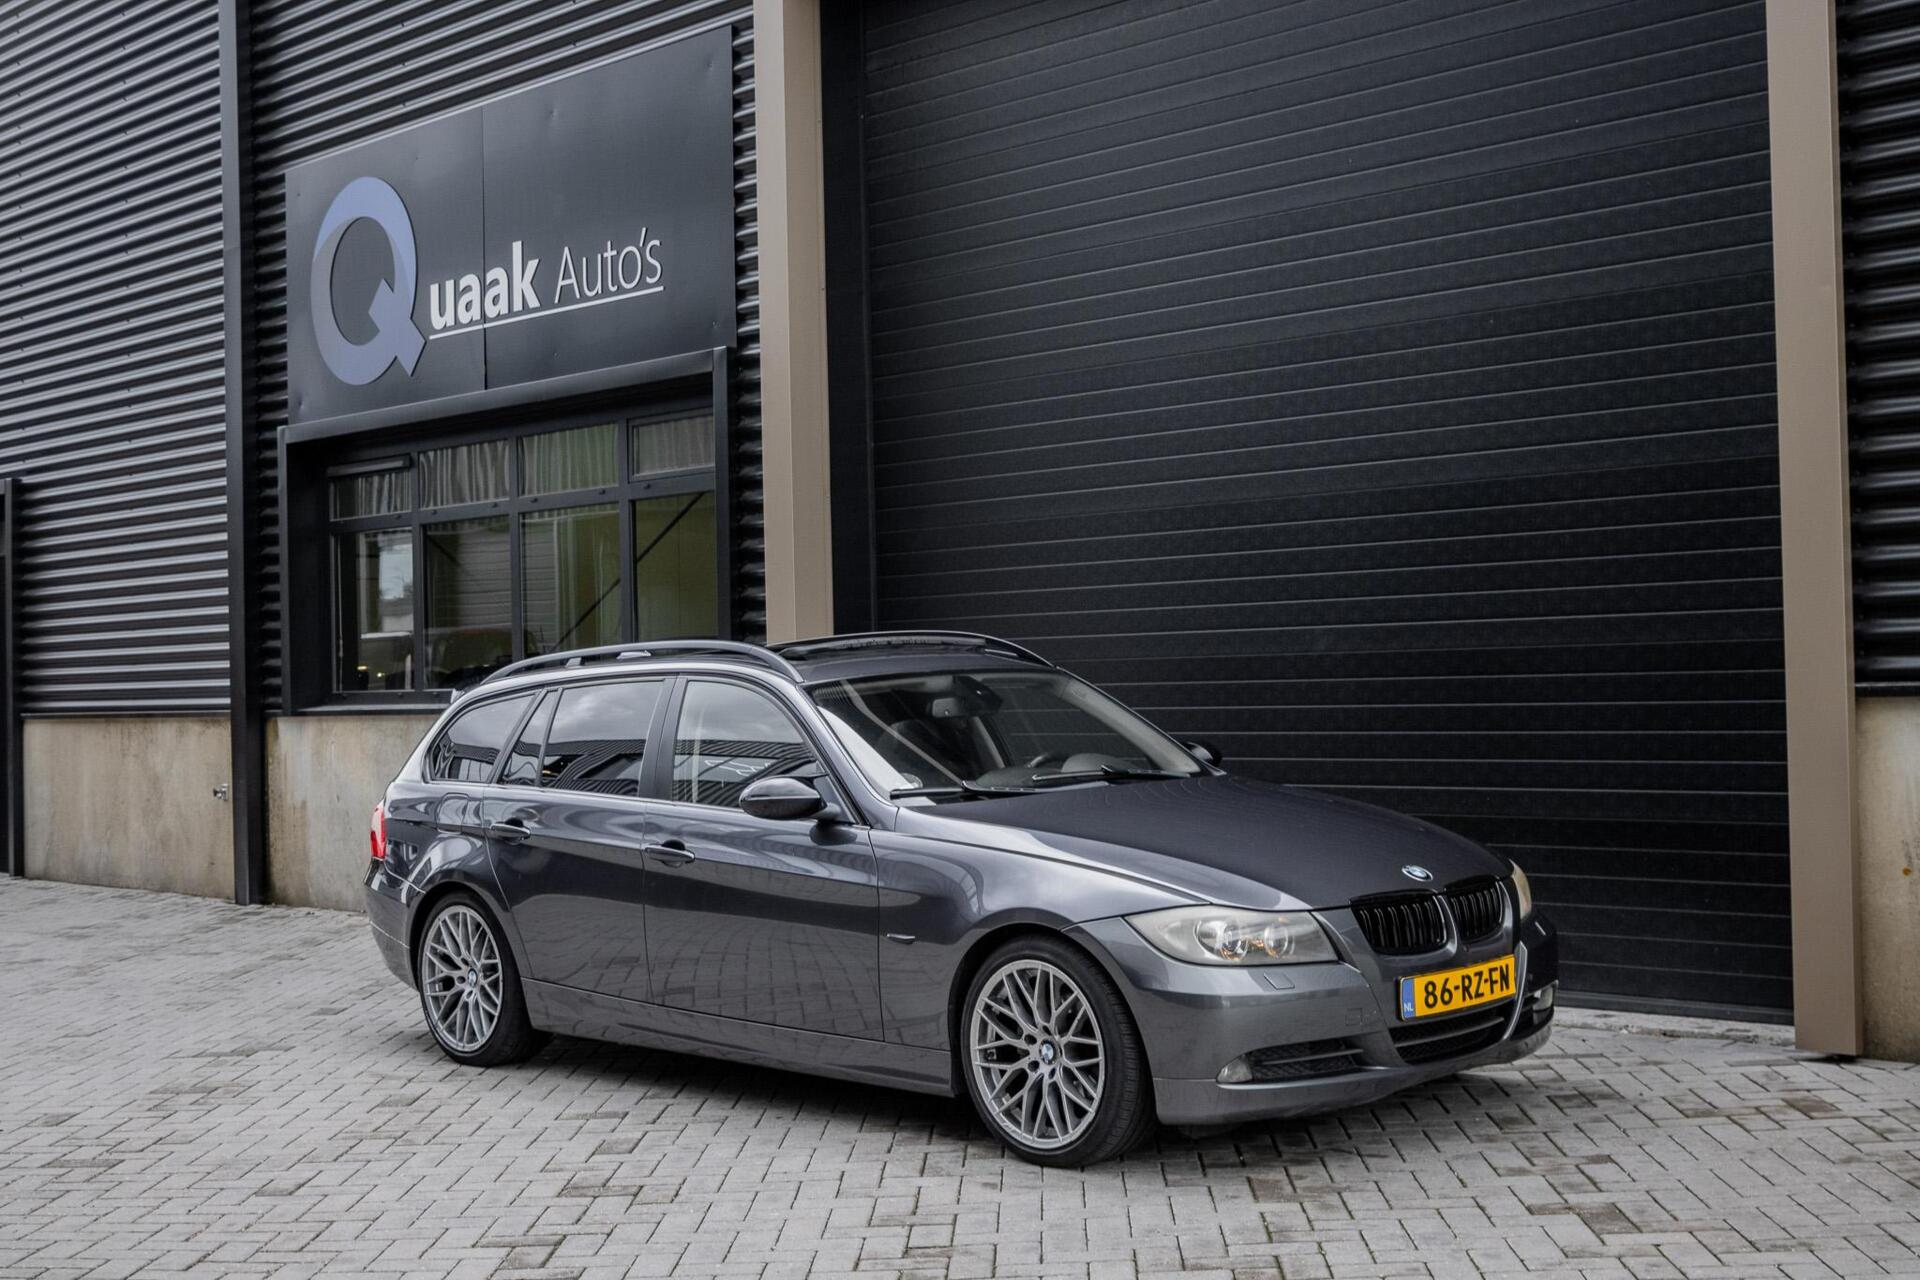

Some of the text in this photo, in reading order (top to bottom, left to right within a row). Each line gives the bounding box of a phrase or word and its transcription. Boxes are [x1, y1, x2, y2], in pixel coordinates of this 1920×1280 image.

[554, 227, 663, 304] Auto's
[1403, 1001, 1414, 1012] NL
[1424, 963, 1510, 1009] 86-RZ-FN
